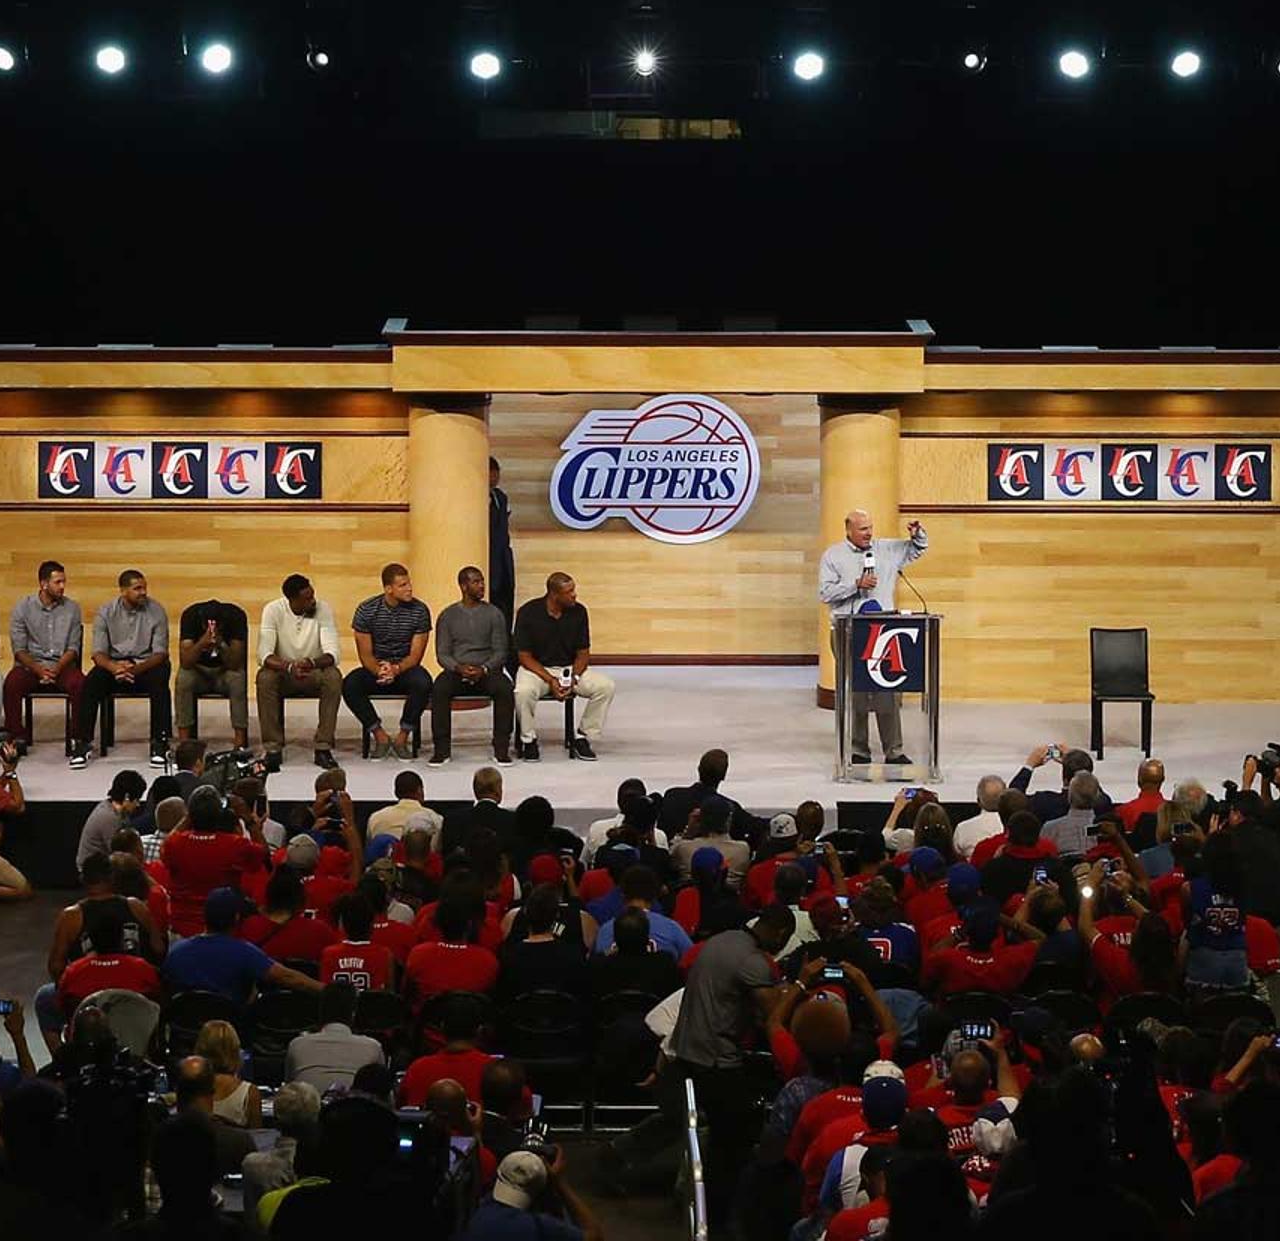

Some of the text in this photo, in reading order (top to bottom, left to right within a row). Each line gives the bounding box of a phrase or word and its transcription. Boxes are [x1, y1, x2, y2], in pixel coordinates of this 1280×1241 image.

[626, 449, 740, 462] LOS ANGELES
[558, 447, 738, 522] CLIPPERS
